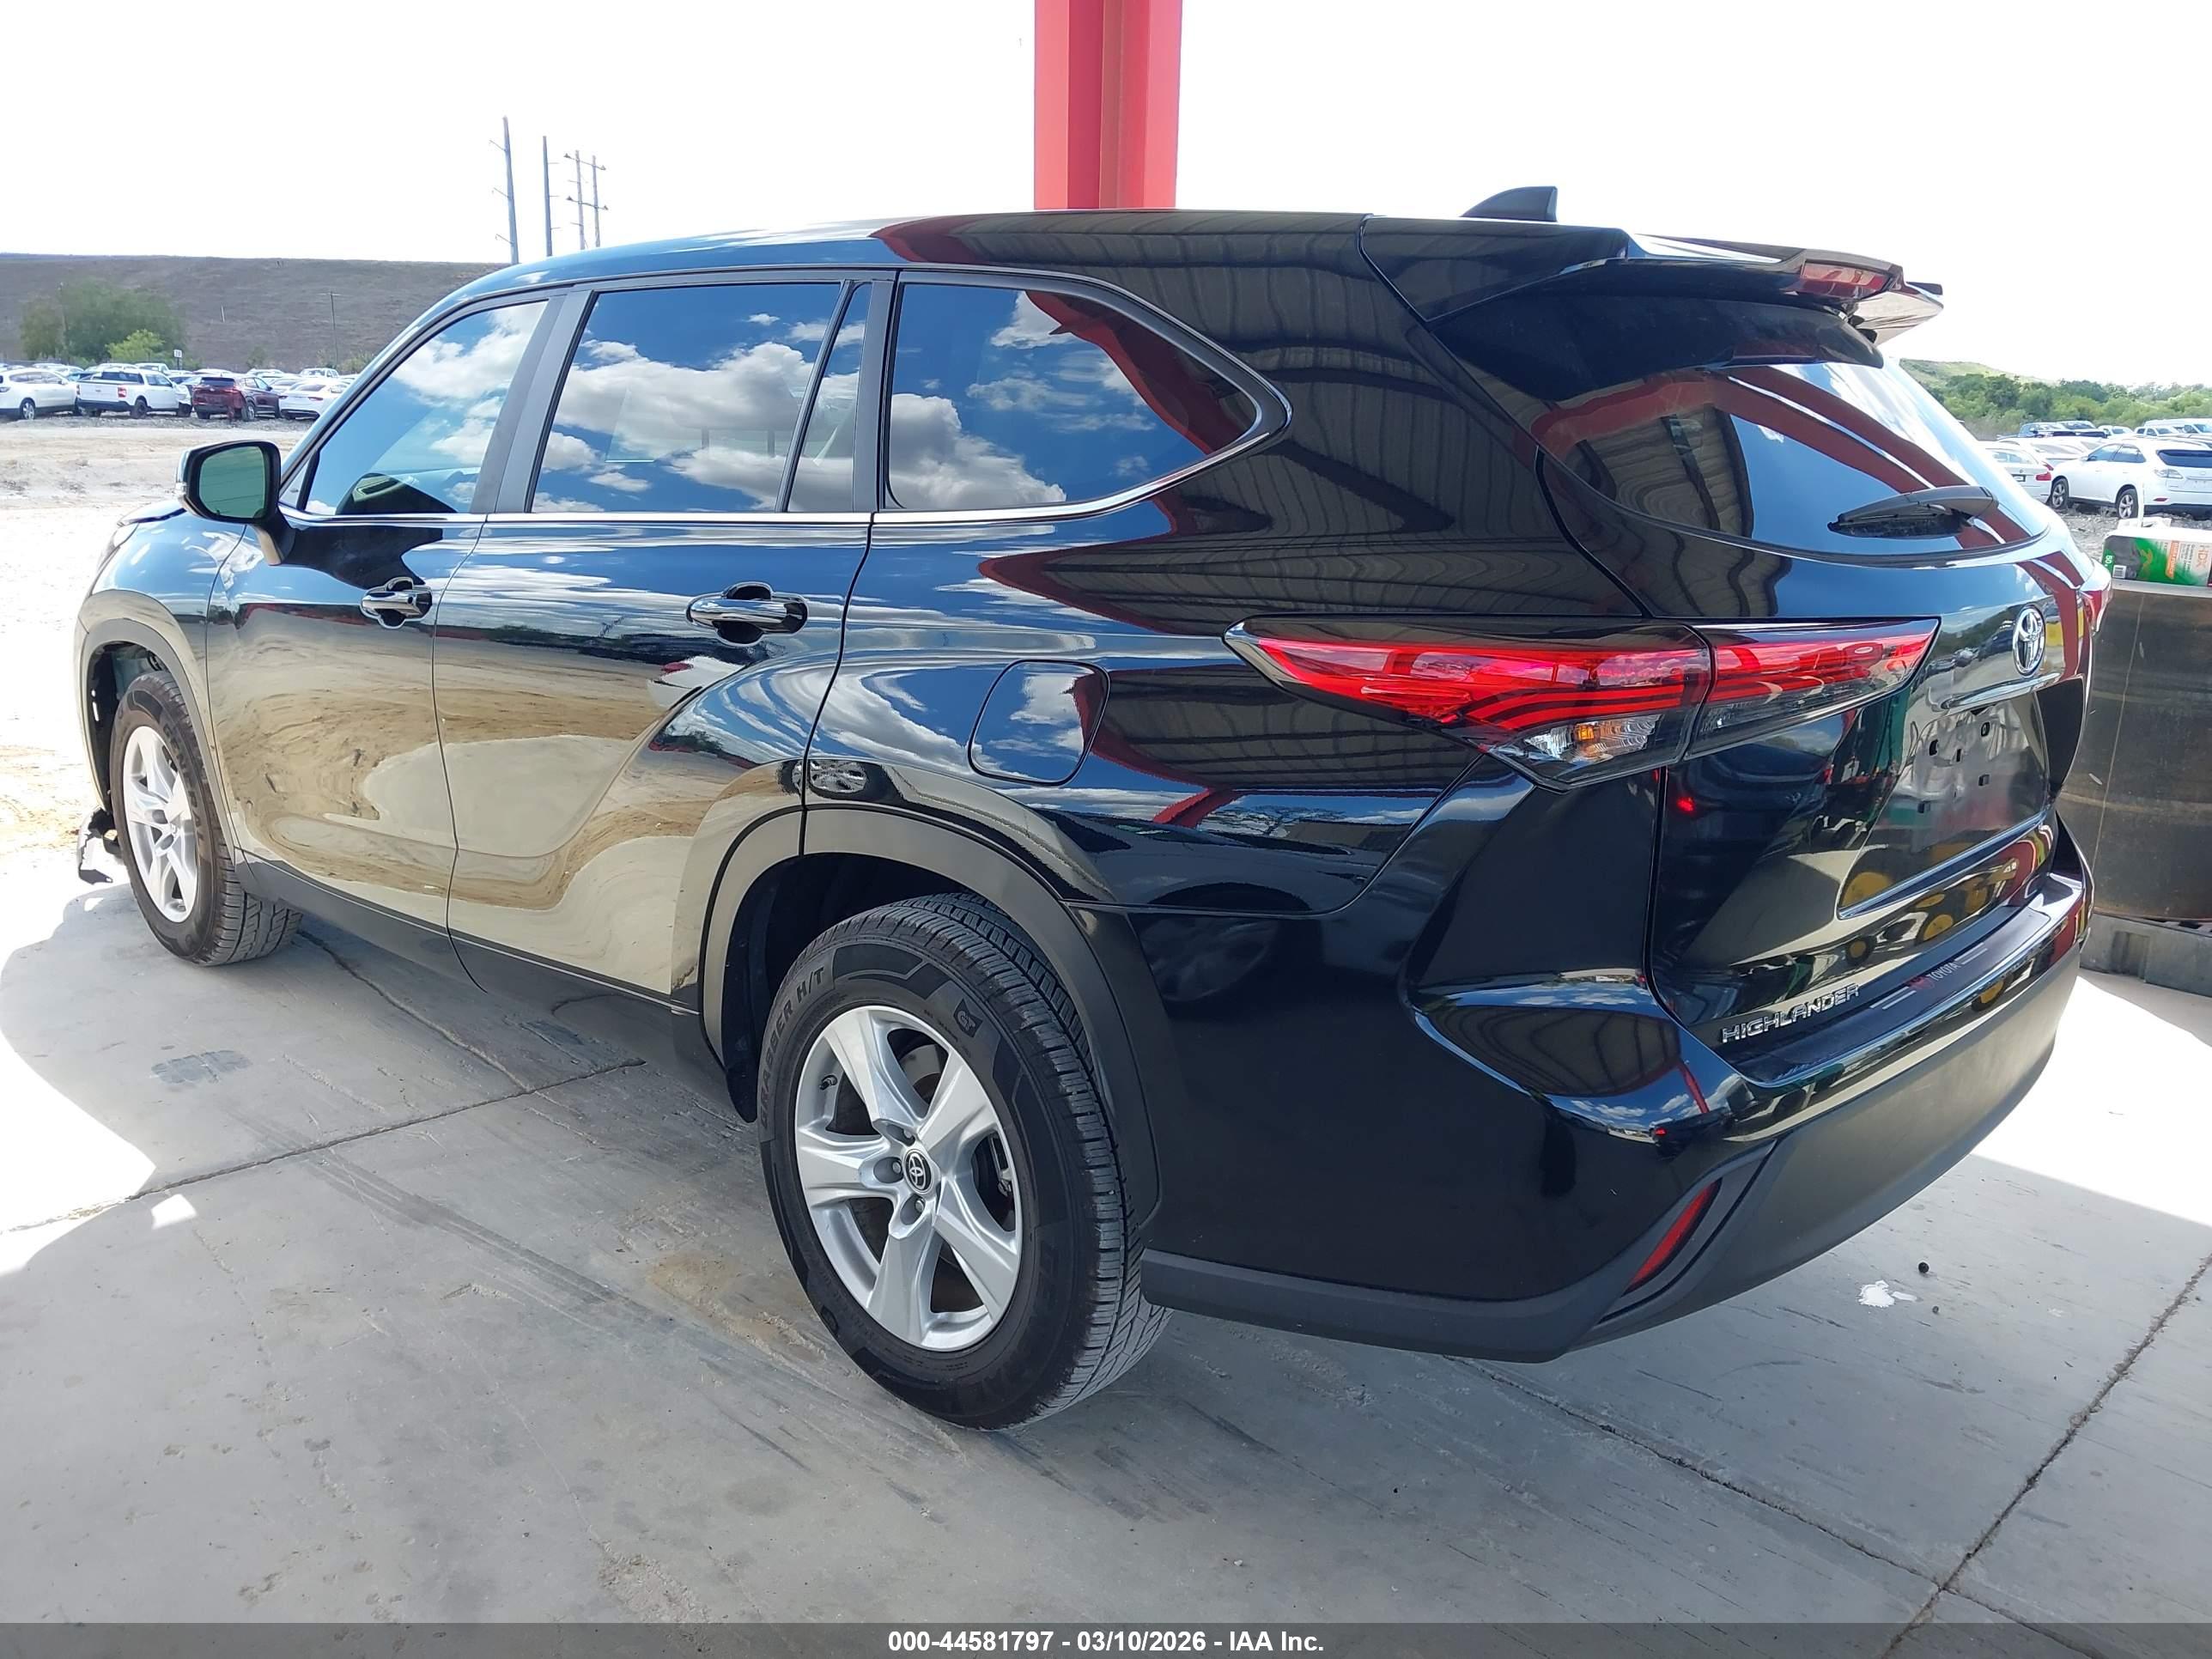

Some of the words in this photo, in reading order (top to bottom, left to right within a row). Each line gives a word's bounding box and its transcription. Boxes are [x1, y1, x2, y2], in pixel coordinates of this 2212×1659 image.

[1926, 960, 1962, 981] TOYOTA
[1723, 983, 1859, 1043] HIGHLANDER
[761, 999, 793, 1129] GRABBER
[796, 966, 825, 1003] H/T
